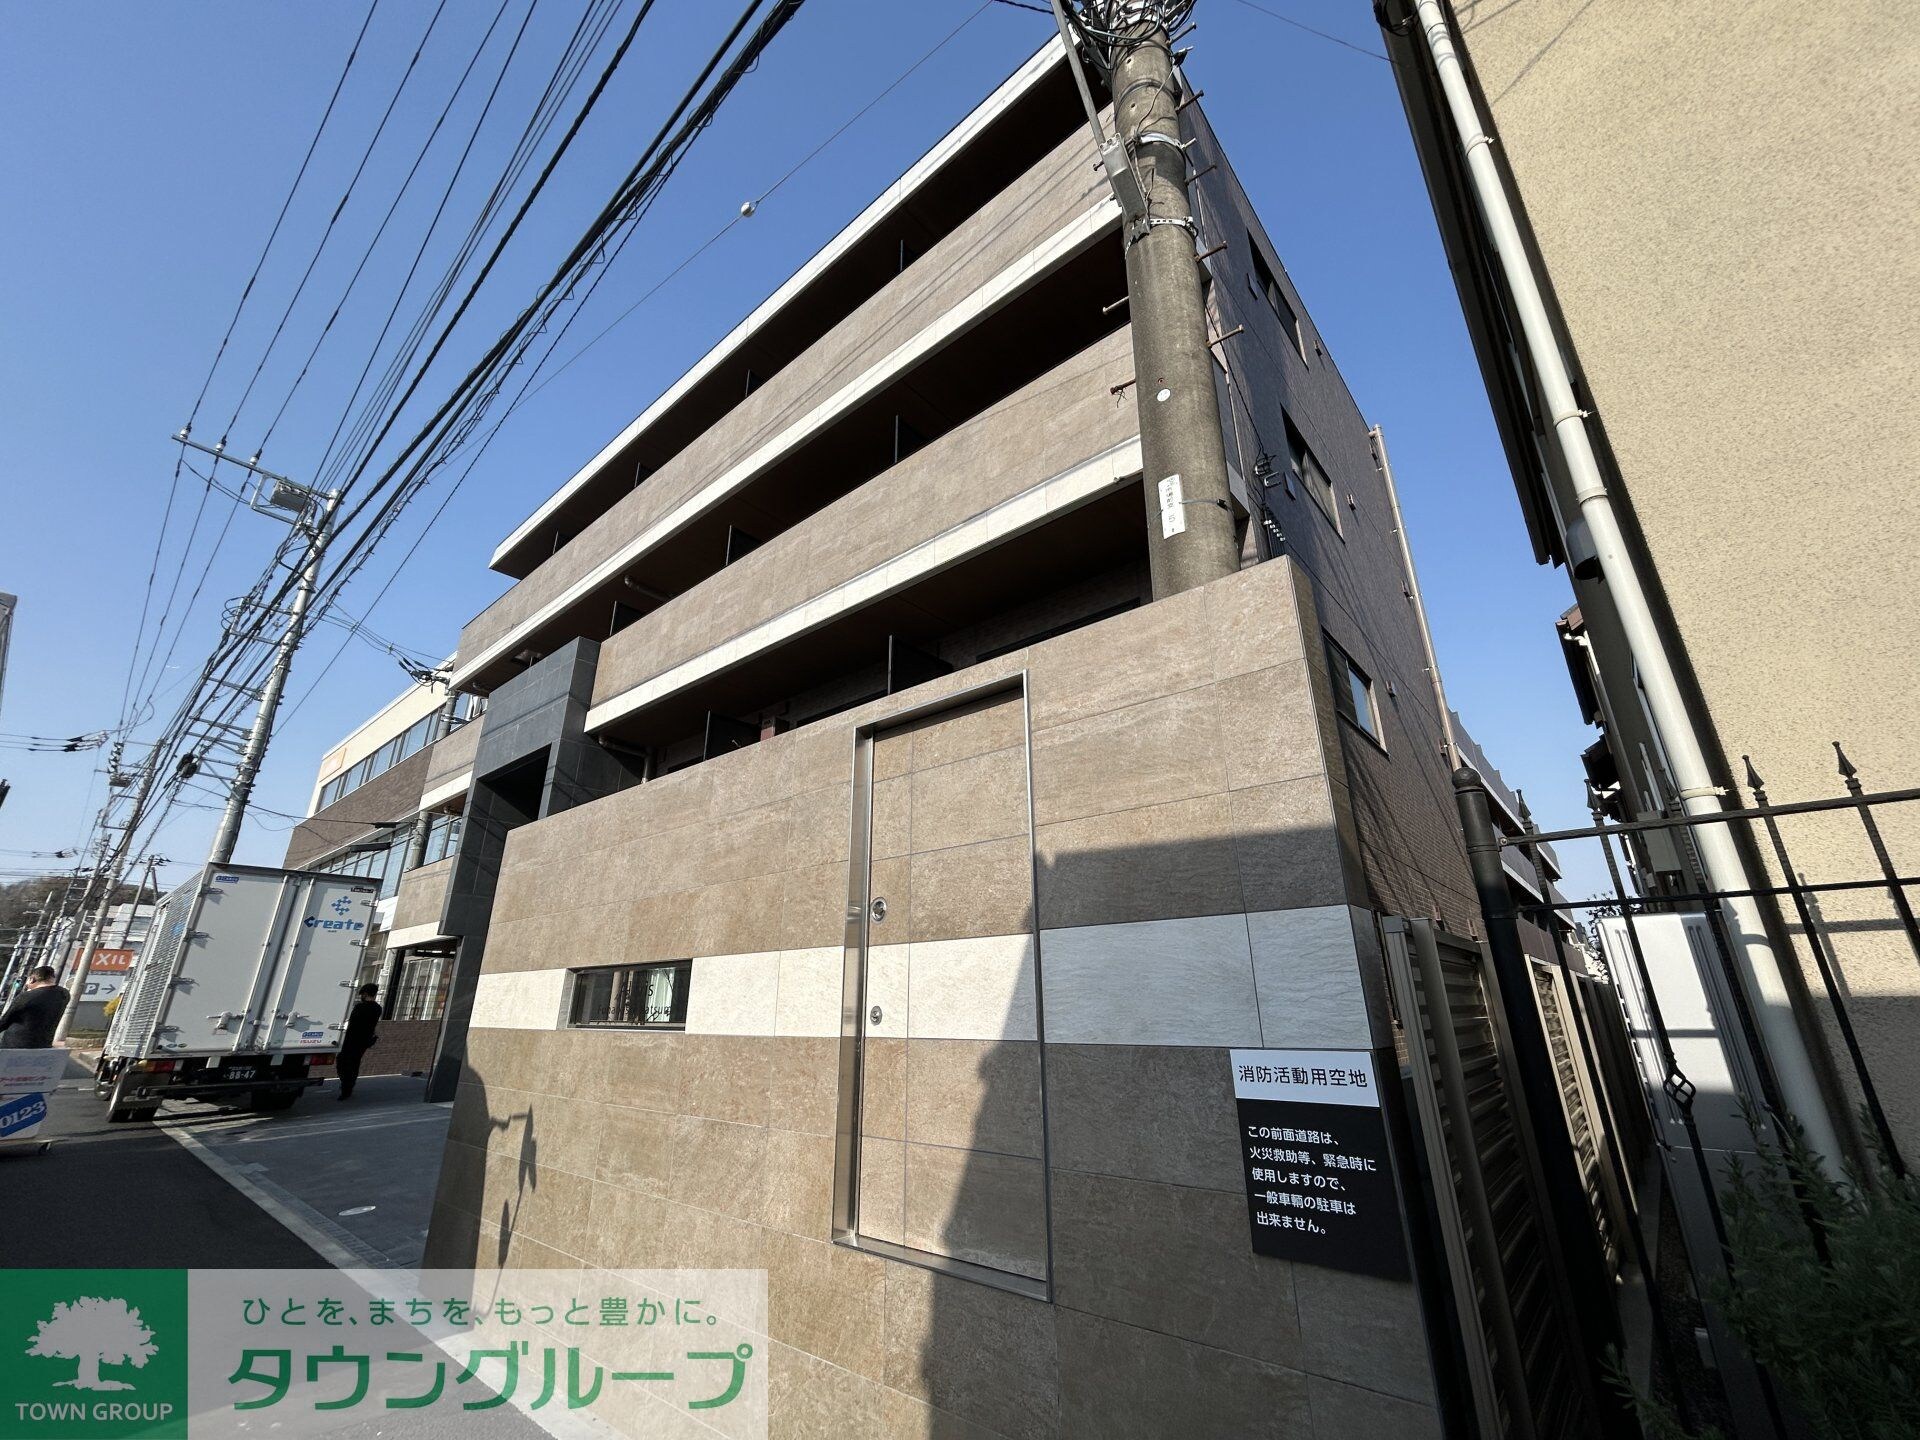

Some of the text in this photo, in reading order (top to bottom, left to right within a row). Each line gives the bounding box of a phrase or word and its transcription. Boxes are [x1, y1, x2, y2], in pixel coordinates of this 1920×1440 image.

[85, 984, 96, 994] P
[1238, 1065, 1368, 1088] 消防活動用空地
[1248, 1126, 1339, 1146] この前面道路は、
[1249, 1147, 1377, 1171] 火災救助等、緊急時に
[1251, 1167, 1346, 1191] 使用しますので、
[1256, 1211, 1326, 1235] 出来ません。
